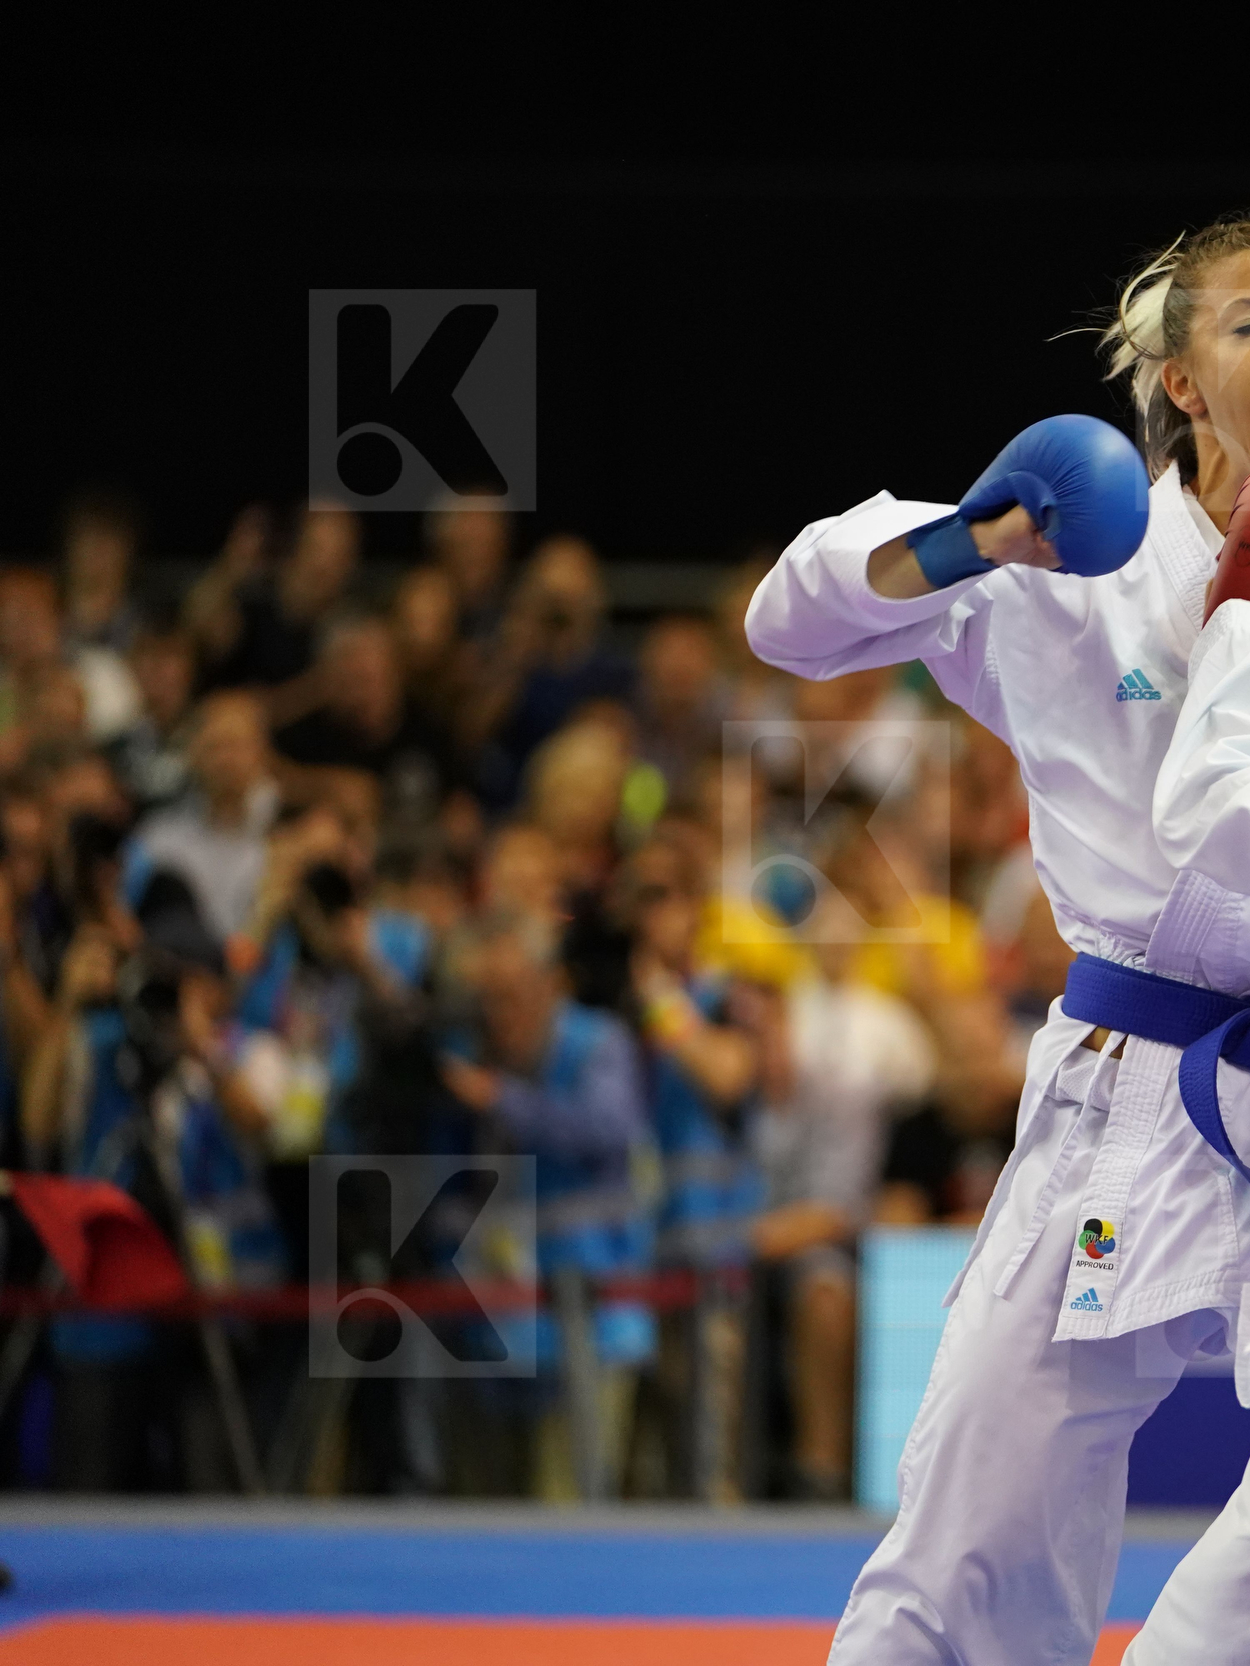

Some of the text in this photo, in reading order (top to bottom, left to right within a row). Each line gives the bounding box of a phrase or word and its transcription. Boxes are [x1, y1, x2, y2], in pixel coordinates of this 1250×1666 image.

[1116, 687, 1162, 702] adidas
[1085, 1233, 1109, 1245] WKF
[1076, 1260, 1114, 1270] APPROVED
[1070, 1300, 1103, 1312] adidas
